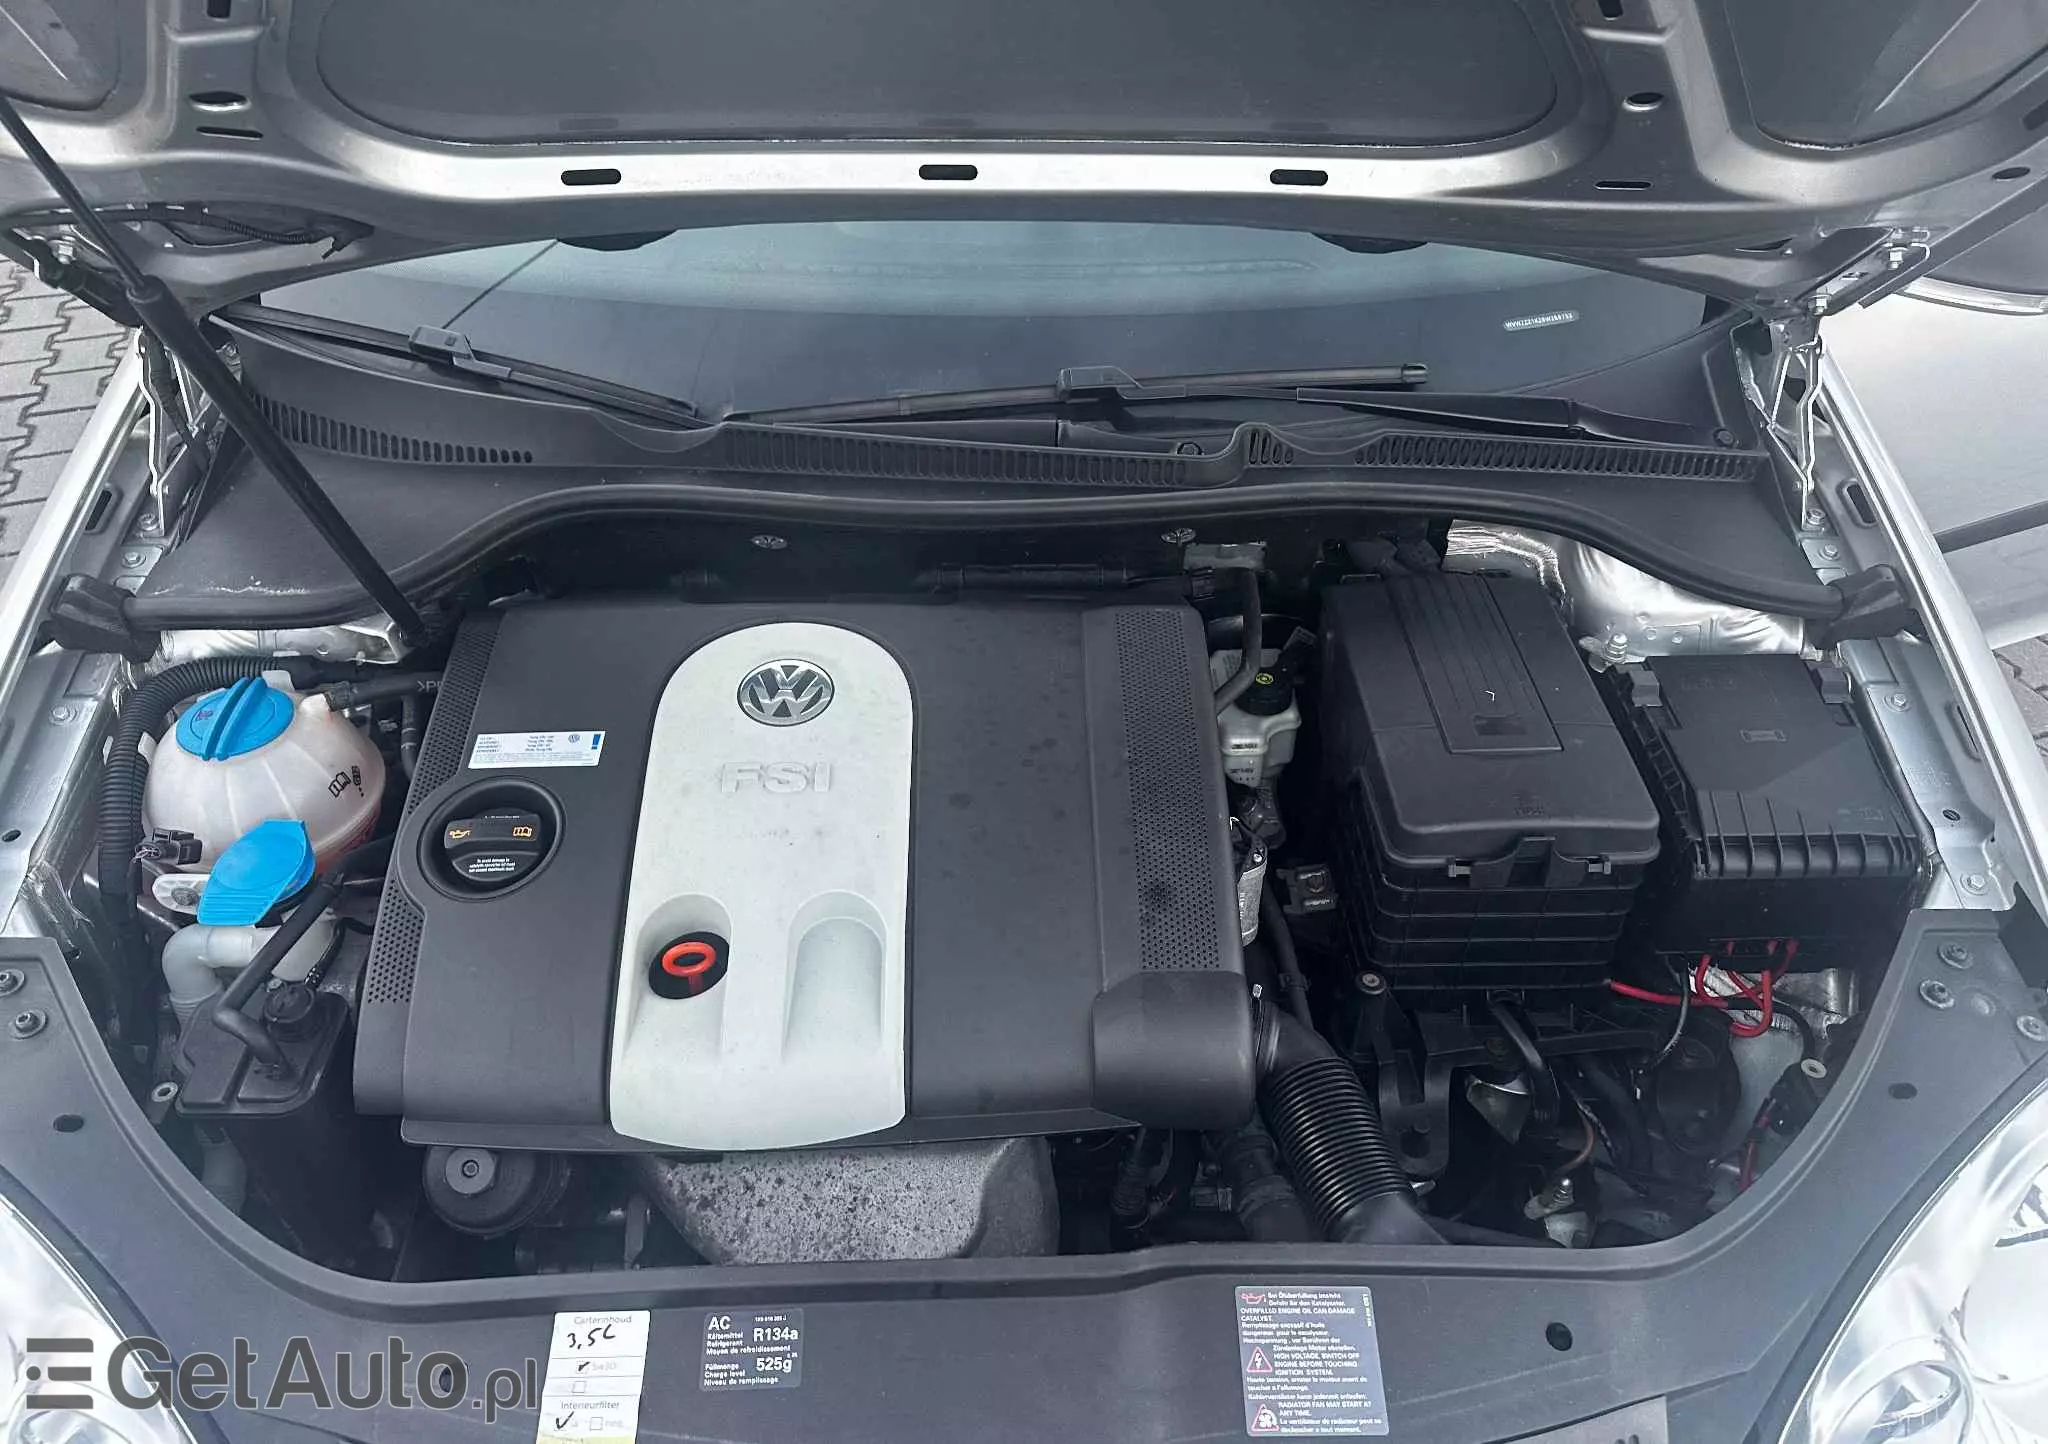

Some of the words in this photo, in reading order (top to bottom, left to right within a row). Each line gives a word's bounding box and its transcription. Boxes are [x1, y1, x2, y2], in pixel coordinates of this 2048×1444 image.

[721, 761, 831, 793] FSI
[574, 1316, 632, 1325] Carterinhoud
[708, 1315, 731, 1331] AC
[753, 1327, 799, 1342] R134a
[756, 1357, 793, 1373] 525g
[704, 1370, 728, 1379] Charge
[729, 1369, 746, 1377] level
